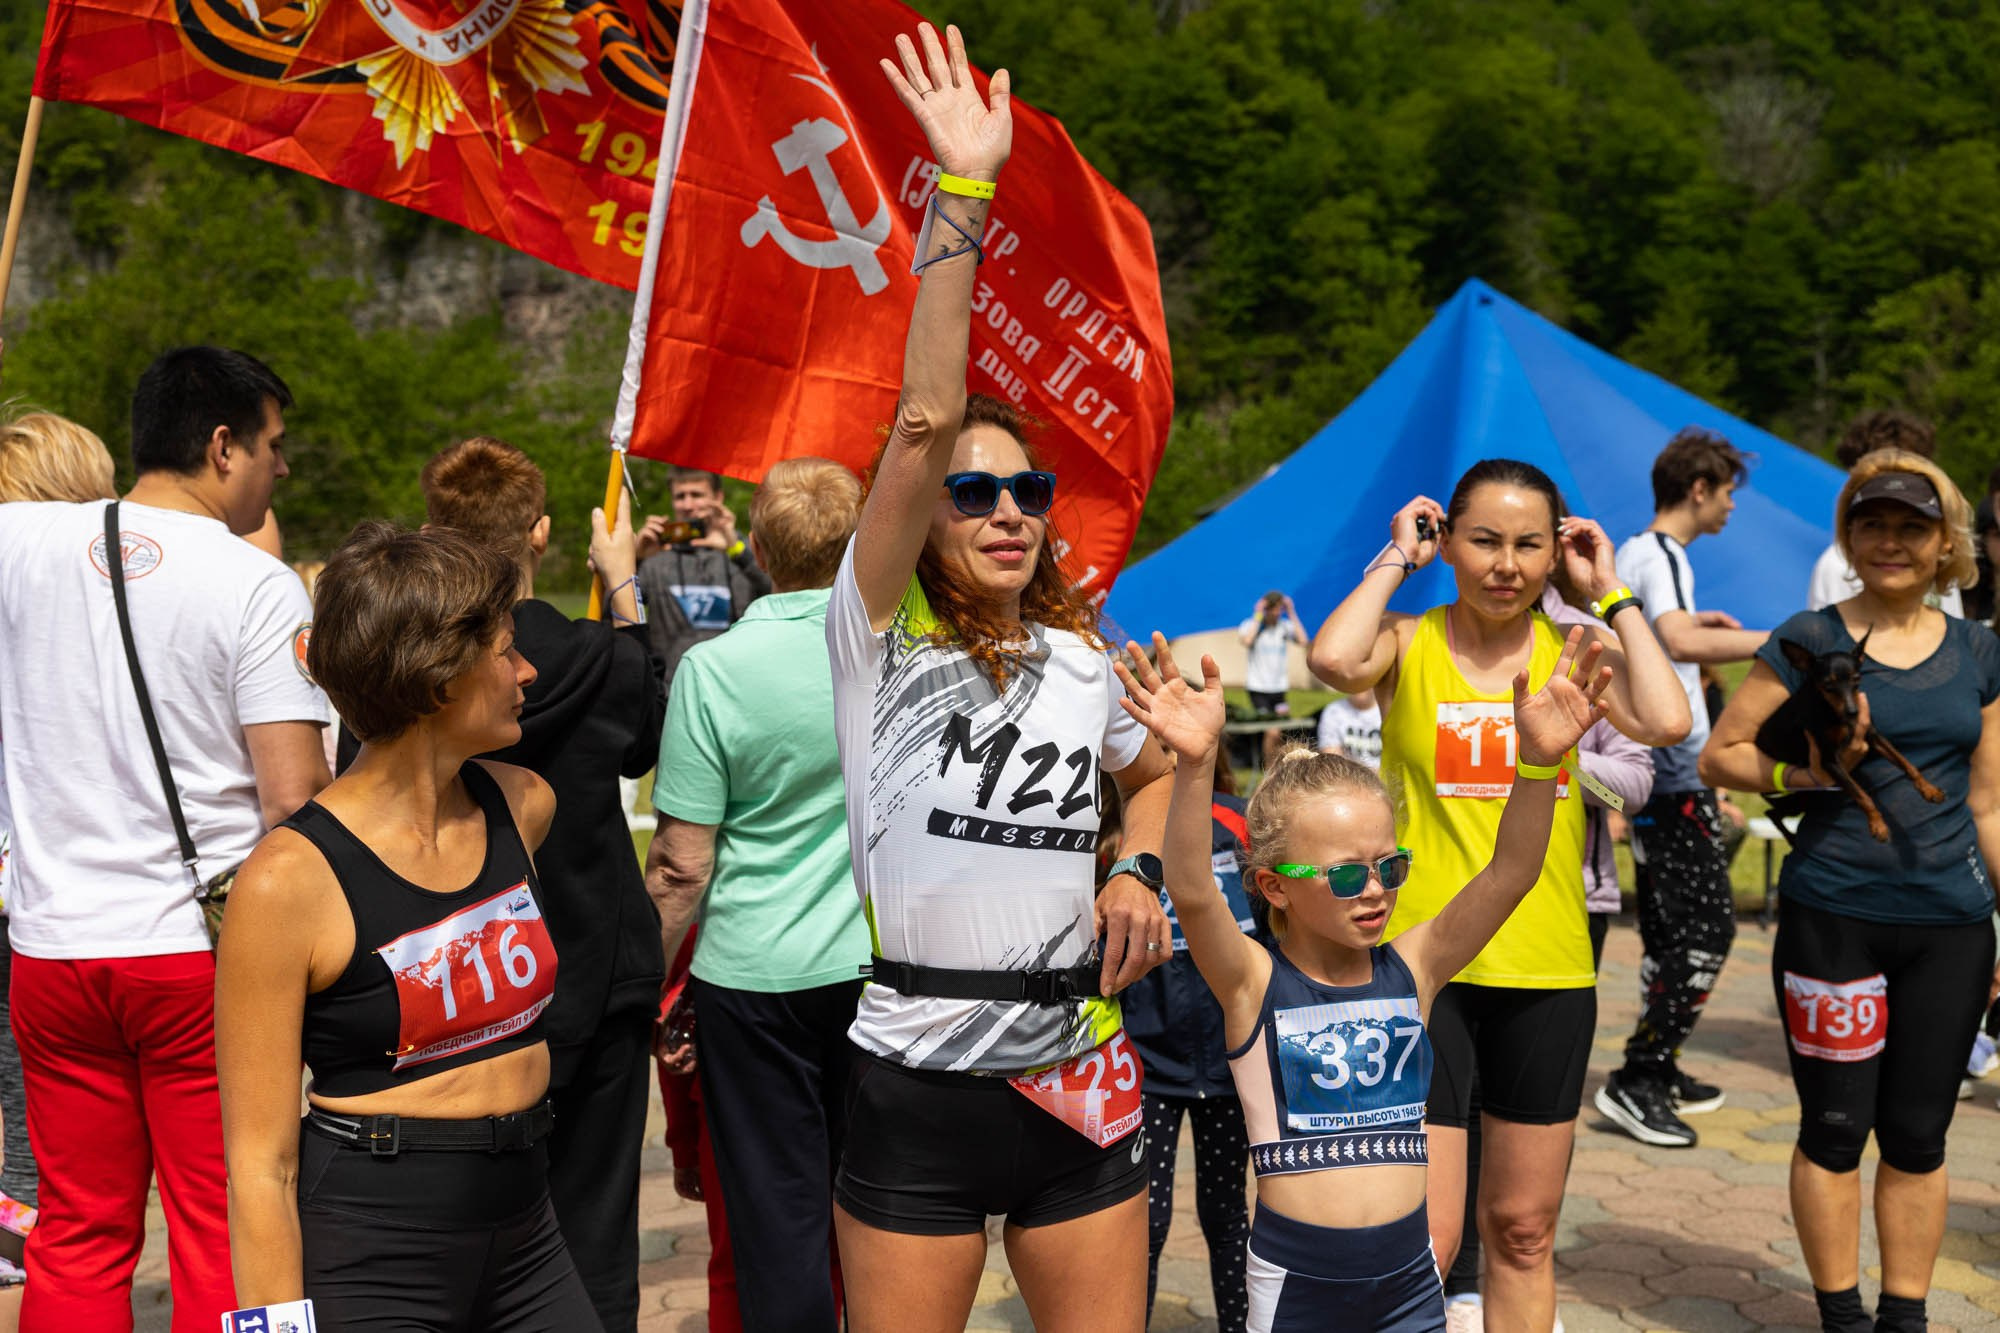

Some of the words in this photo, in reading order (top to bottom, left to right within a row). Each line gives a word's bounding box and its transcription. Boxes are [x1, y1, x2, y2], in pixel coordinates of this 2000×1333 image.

[575, 121, 659, 180] 19
[982, 217, 1020, 277] ТР.
[971, 282, 1042, 365] ЗОВА
[1464, 722, 1517, 768] 11
[426, 923, 538, 1021] 116
[418, 1028, 485, 1057] ПОБЕДНЫЙ
[487, 1015, 522, 1038] ТРЕЙЛ
[523, 1012, 530, 1026] 9
[1798, 997, 1878, 1039] 139
[1310, 1025, 1423, 1090] 337
[1105, 1115, 1134, 1140] ТРЕЙЛ
[1309, 1115, 1355, 1128] ШТУРМ
[1357, 1109, 1401, 1126] ВЫСОТЫ
[1401, 1107, 1418, 1120] 1945
